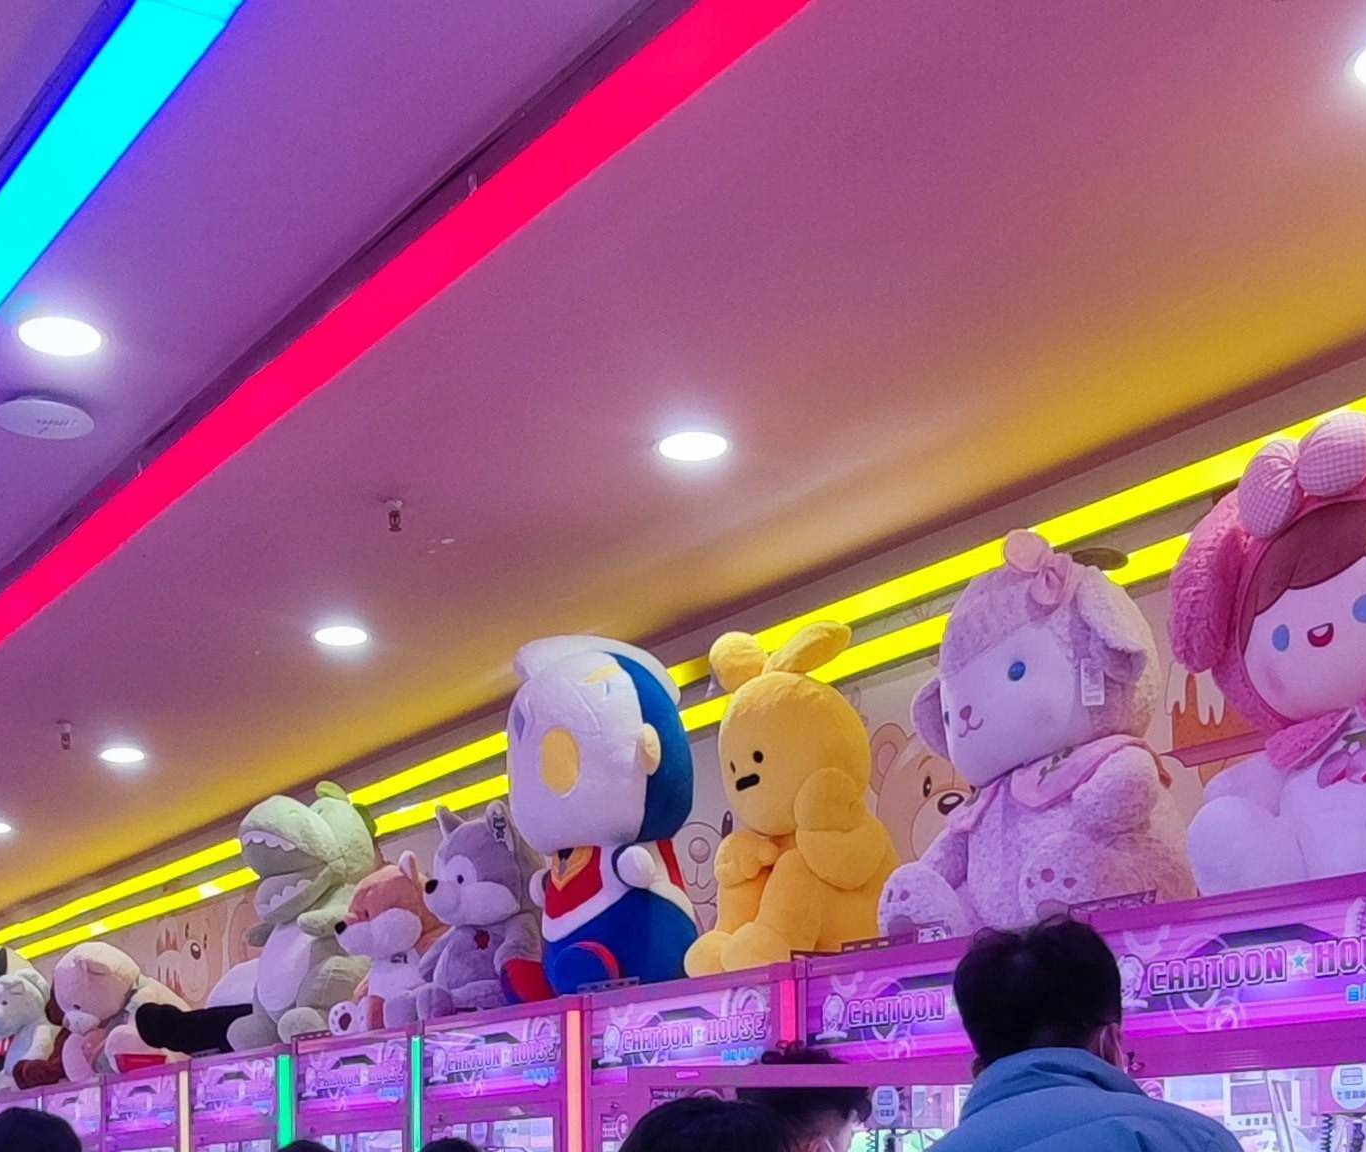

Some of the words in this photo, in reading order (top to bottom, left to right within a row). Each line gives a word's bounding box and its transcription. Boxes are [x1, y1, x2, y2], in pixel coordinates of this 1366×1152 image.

[1146, 946, 1287, 997] CARTOON
[847, 988, 945, 1029] CARTOON
[621, 1020, 693, 1055] CARTOON
[706, 1012, 767, 1046] HOUSE
